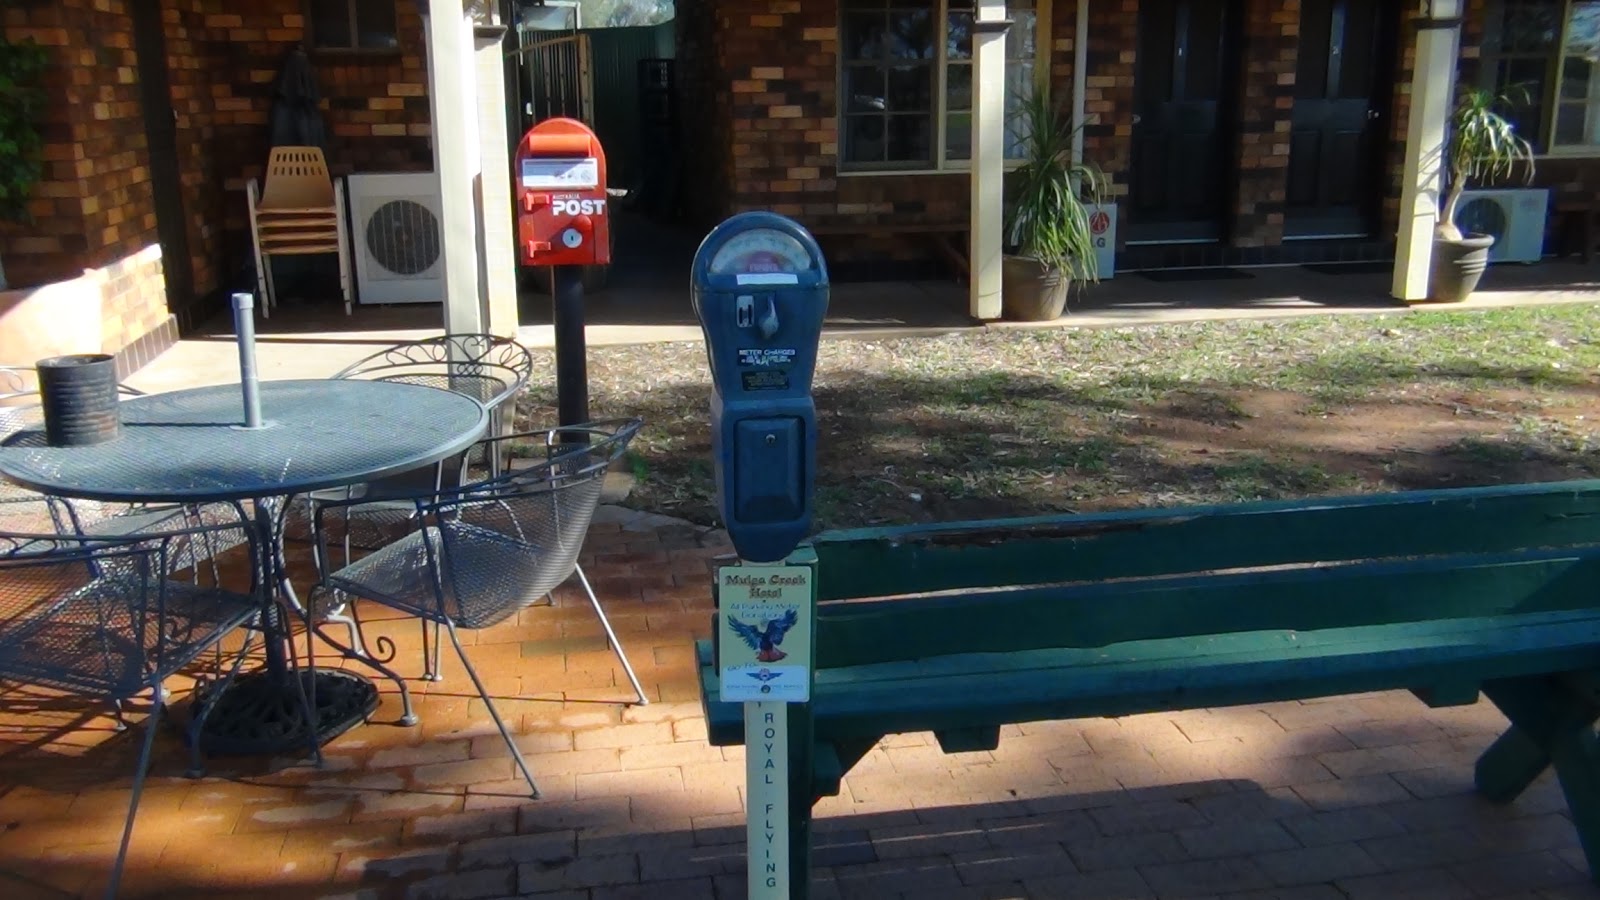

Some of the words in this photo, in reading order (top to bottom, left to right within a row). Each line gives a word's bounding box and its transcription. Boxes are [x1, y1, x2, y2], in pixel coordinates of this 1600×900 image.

[552, 199, 606, 216] POST
[725, 574, 767, 586] Mulga
[768, 574, 807, 586] Creek
[748, 587, 783, 599] Hotel
[764, 712, 776, 785] ROYAL
[765, 803, 777, 888] FLYING
